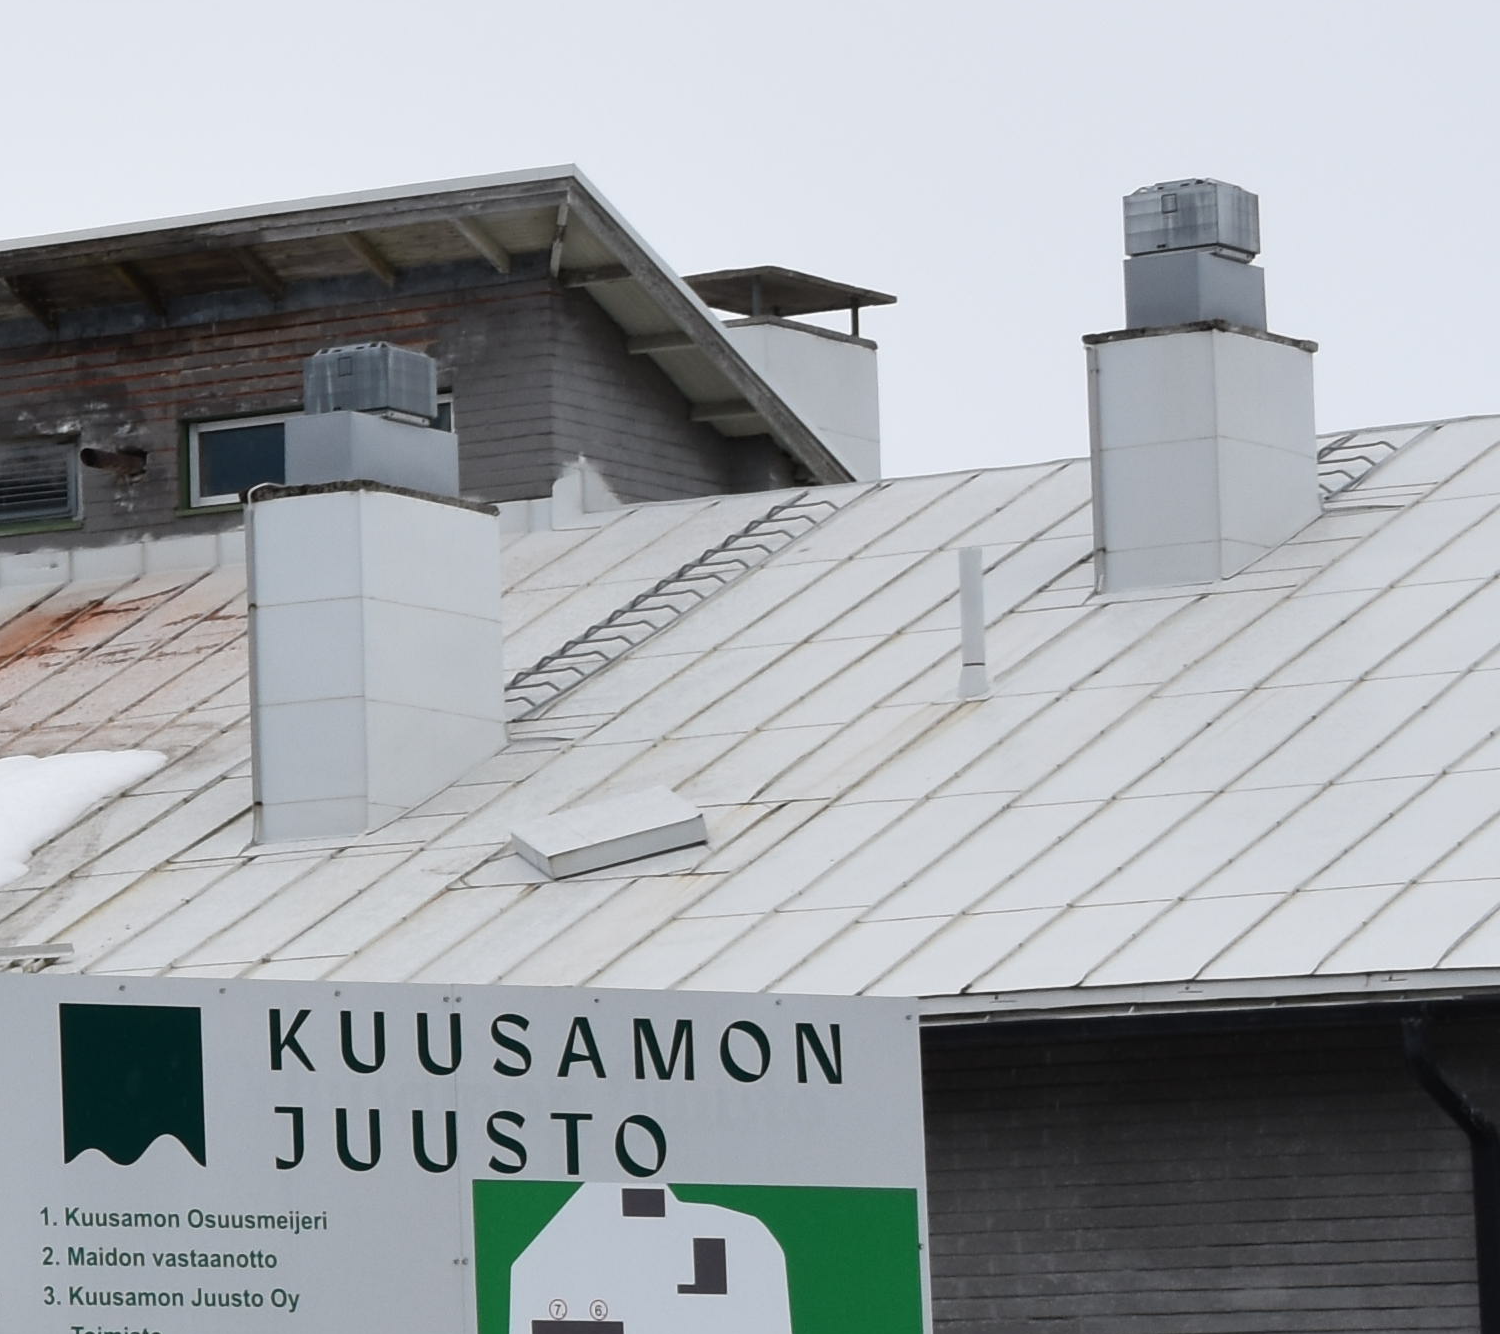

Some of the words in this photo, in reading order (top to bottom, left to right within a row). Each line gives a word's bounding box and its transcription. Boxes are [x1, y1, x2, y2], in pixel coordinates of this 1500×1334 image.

[268, 1008, 843, 1085] KUUSAMON
[274, 1106, 667, 1179] JUUSTO
[40, 1206, 58, 1227] 1.
[65, 1206, 180, 1228] Kuusamon
[187, 1208, 328, 1235] Osuusmeijeri
[42, 1246, 60, 1266] 2.
[67, 1246, 146, 1267] Maidon
[152, 1249, 278, 1269] vastaanotto
[43, 1285, 62, 1306] 3.
[68, 1286, 184, 1307] Kuusamon
[191, 1287, 264, 1308] Juusto
[270, 1288, 300, 1313] Oy
